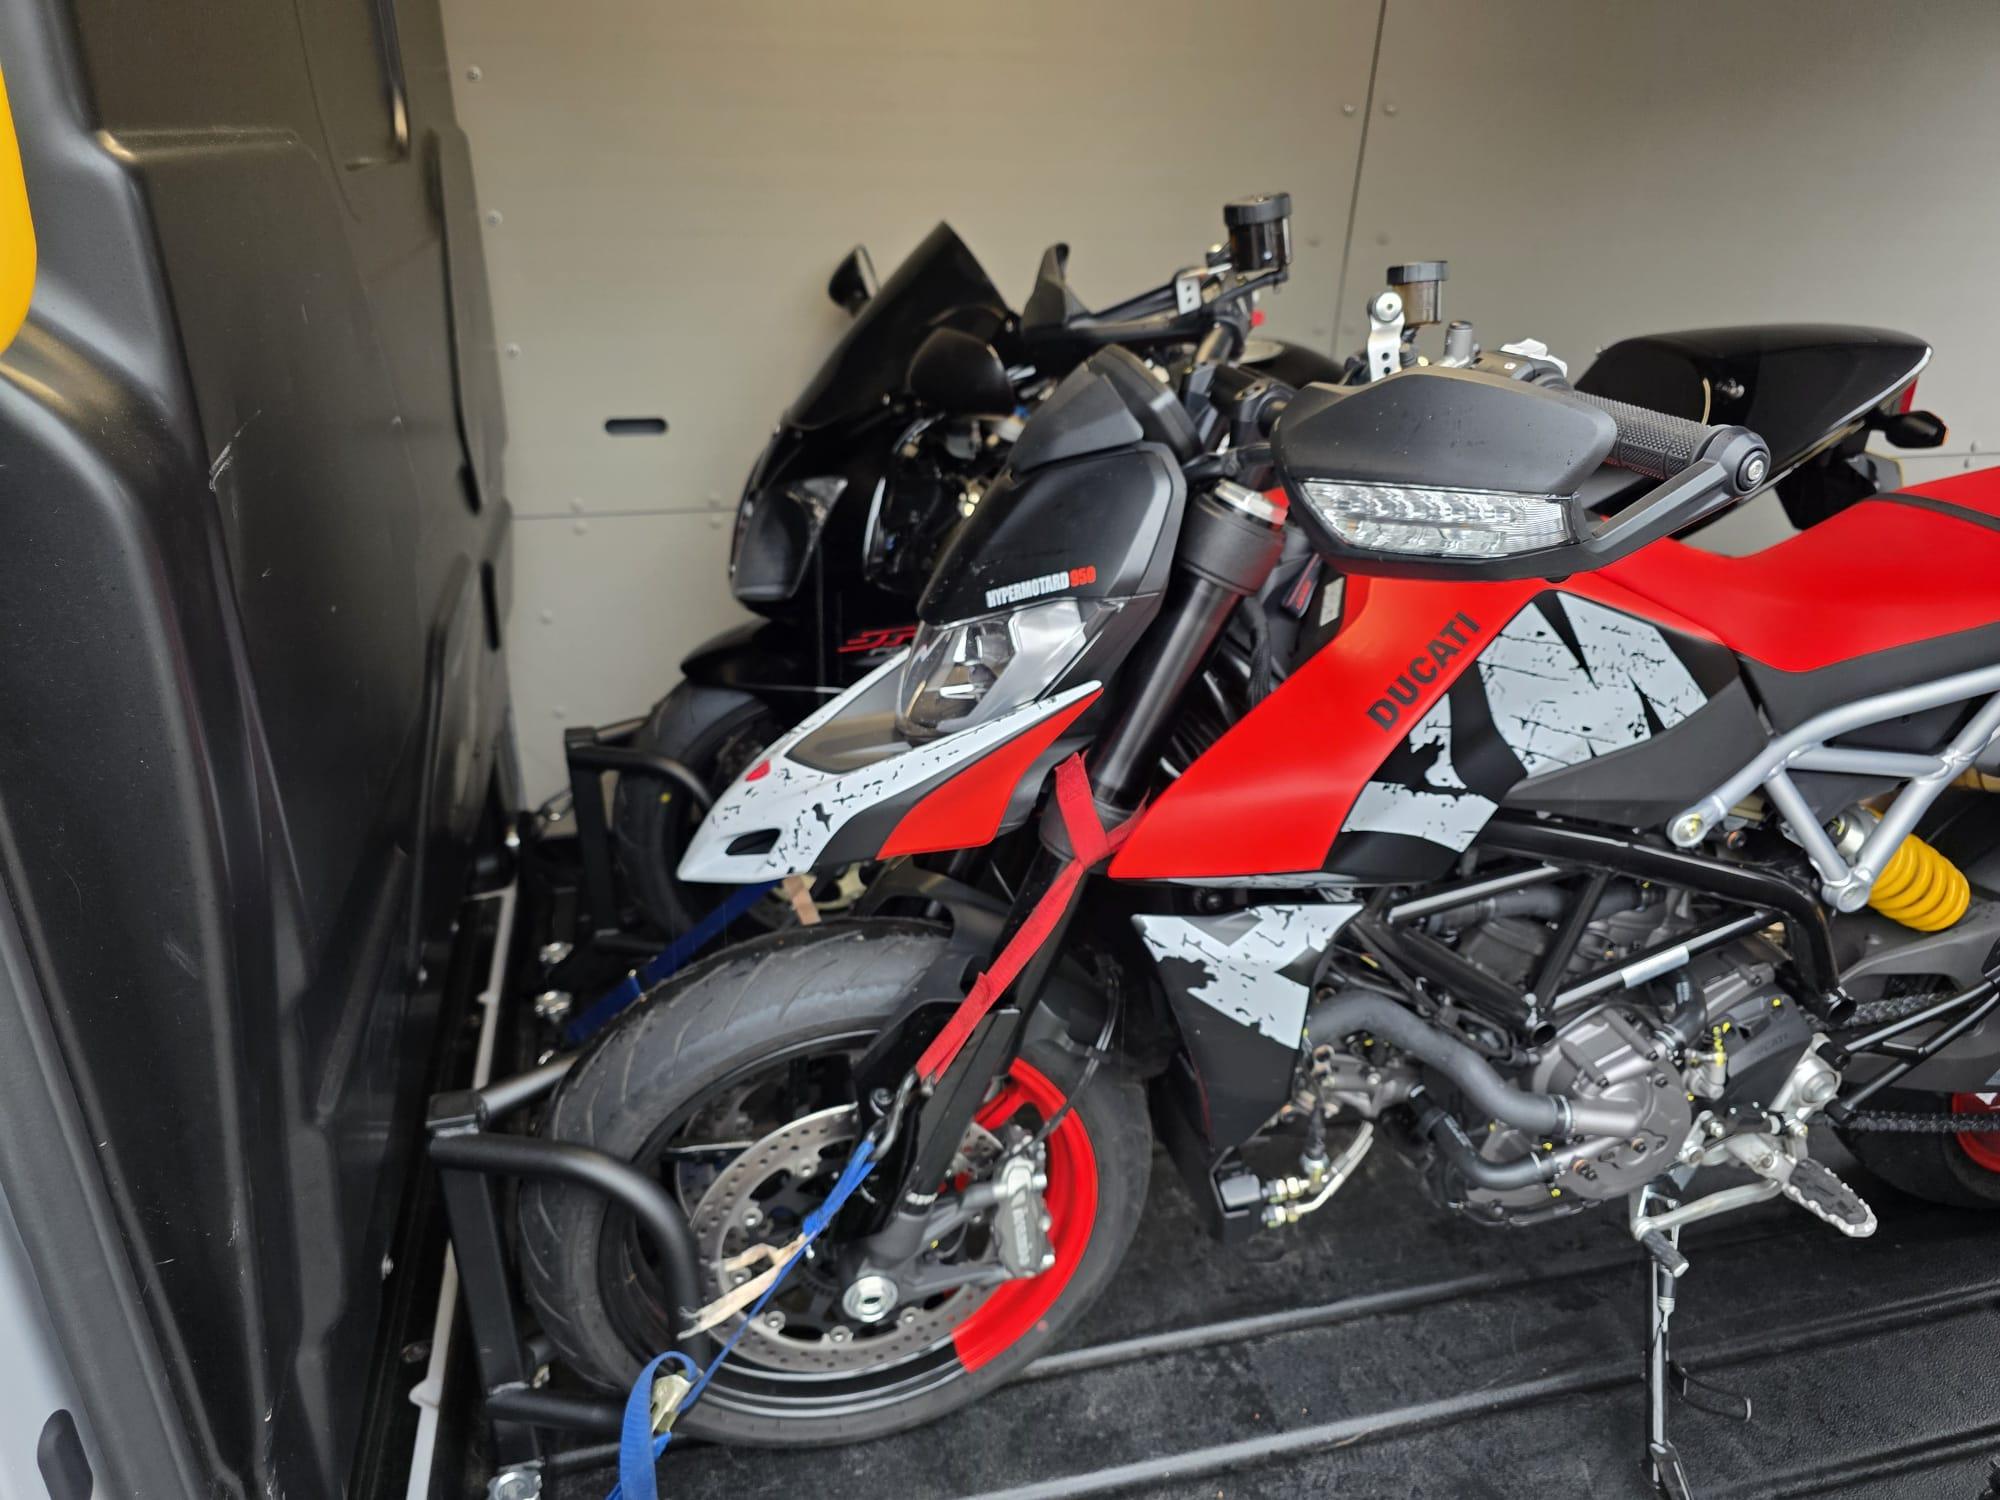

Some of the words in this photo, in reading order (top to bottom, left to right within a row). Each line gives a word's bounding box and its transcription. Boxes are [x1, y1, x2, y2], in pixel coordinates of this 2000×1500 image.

[985, 571, 1070, 609] HYPERMOTARD
[1069, 565, 1097, 588] 950
[1367, 611, 1480, 732] DUCATI
